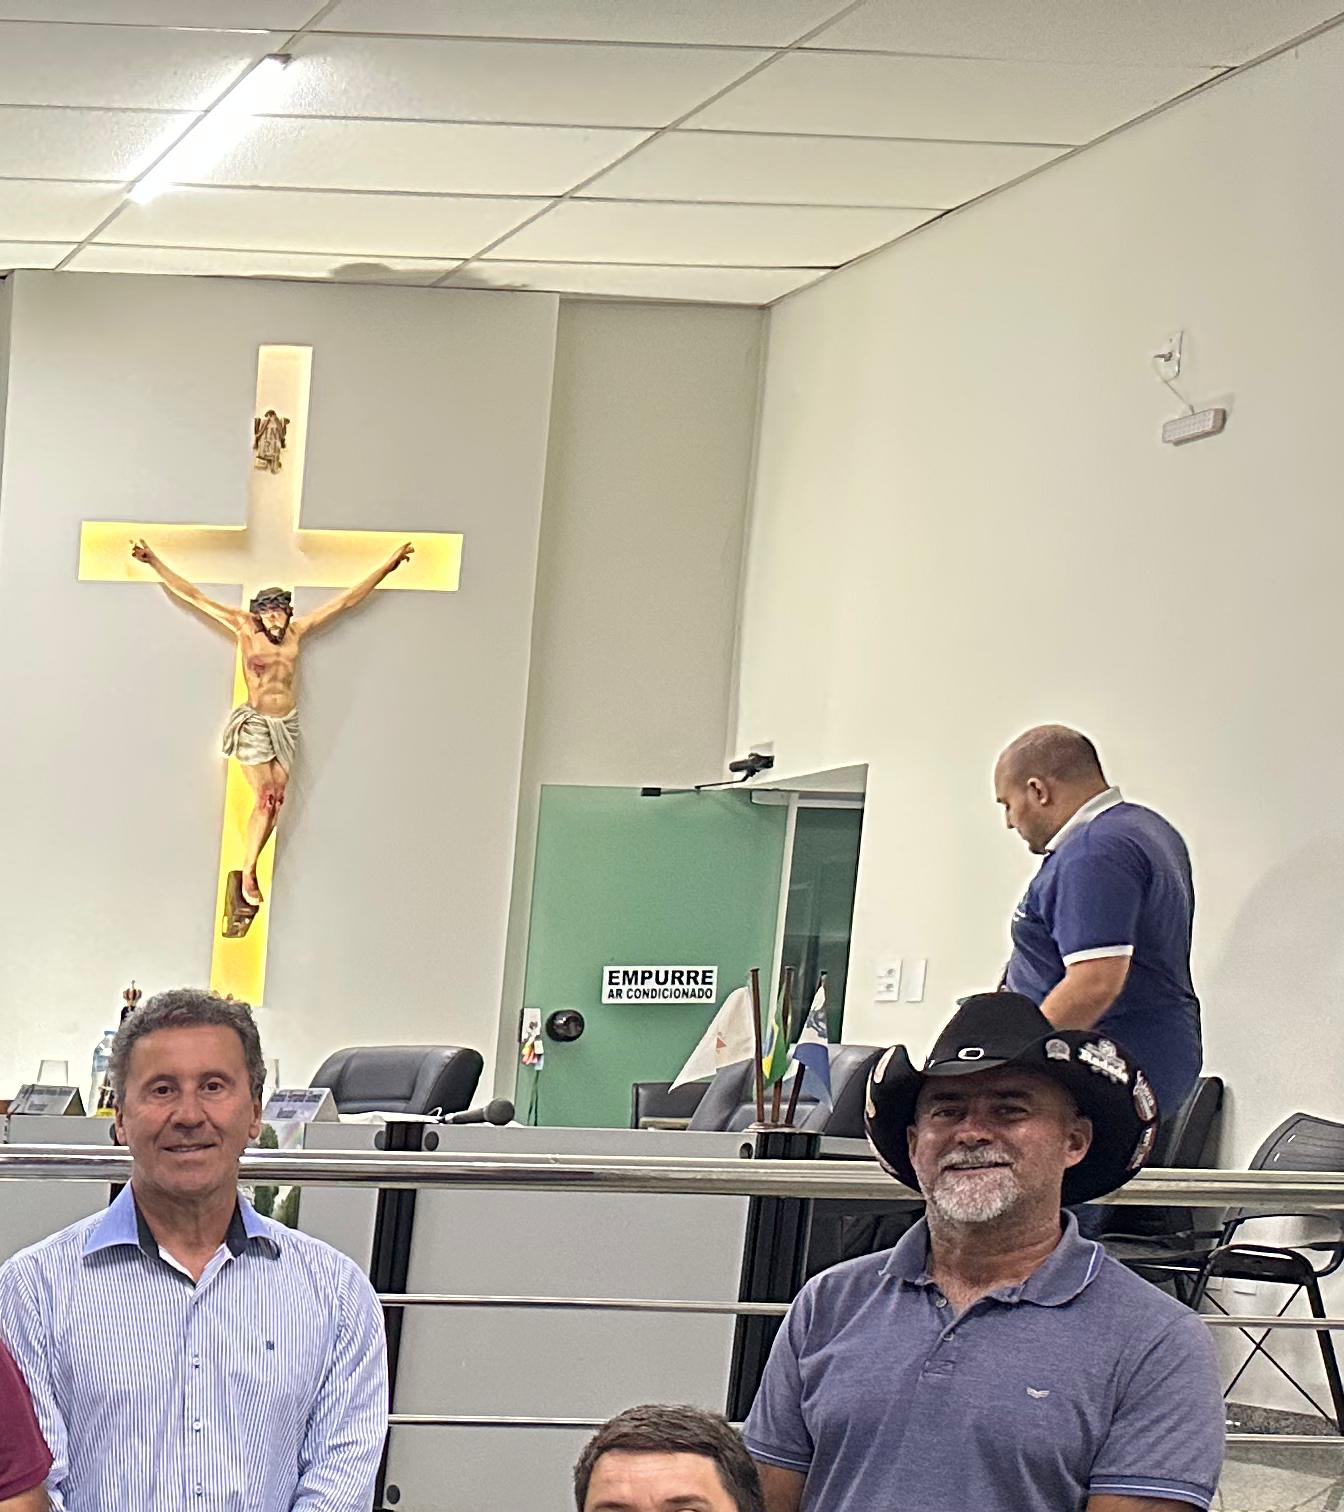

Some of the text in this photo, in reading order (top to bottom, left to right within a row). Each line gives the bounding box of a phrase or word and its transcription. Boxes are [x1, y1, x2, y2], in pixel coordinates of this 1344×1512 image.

[607, 969, 714, 986] EMPURRE
[607, 988, 713, 999] AR CONDICIONADO
